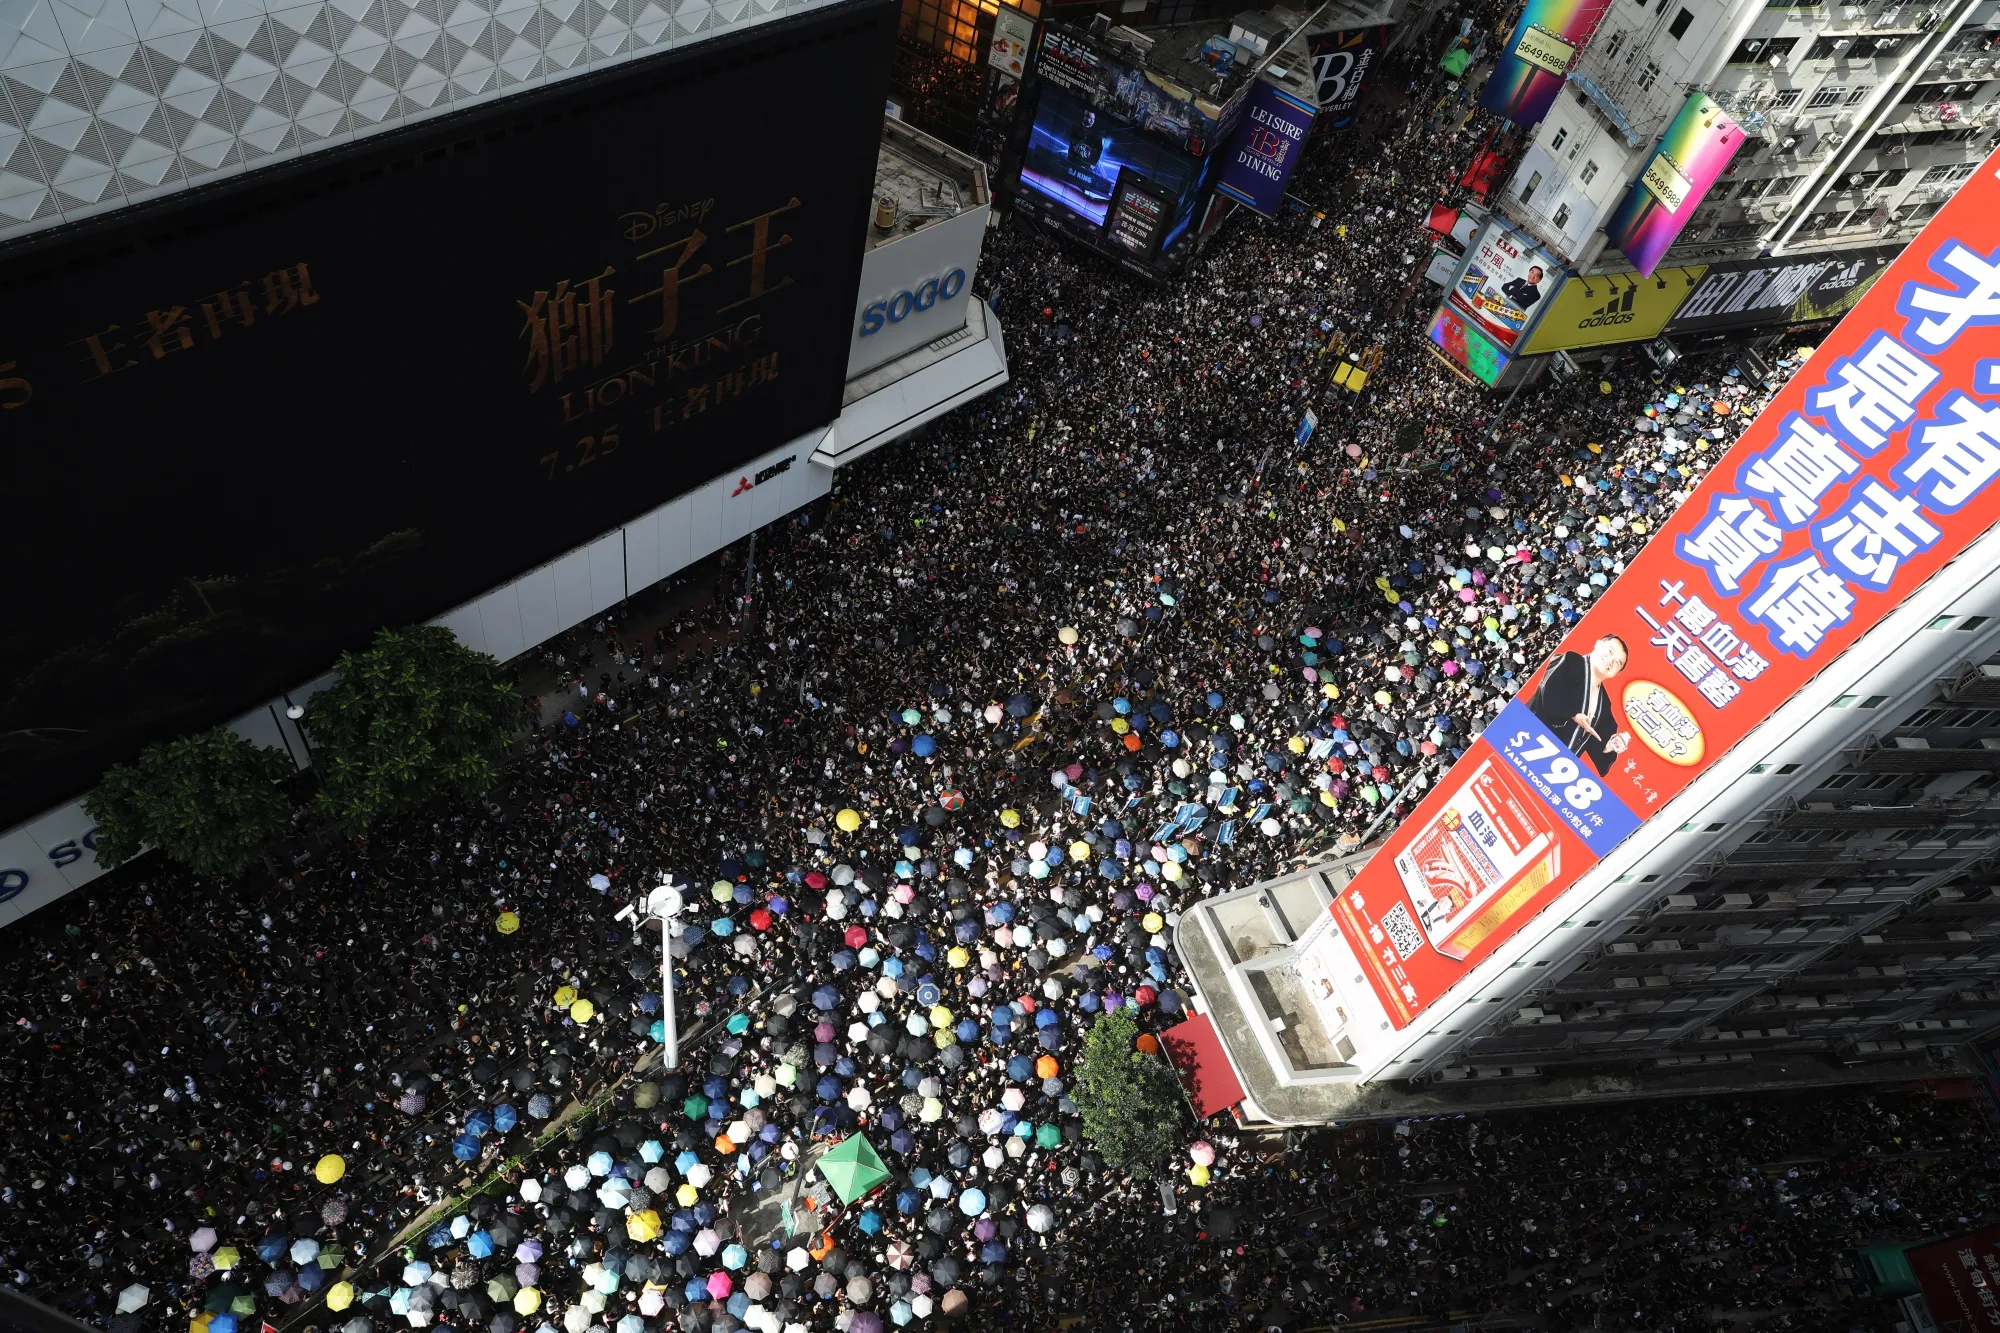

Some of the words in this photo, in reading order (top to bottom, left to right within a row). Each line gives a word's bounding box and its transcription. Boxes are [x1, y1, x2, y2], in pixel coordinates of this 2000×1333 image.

[1341, 48, 1375, 101] 金百利
[1250, 105, 1304, 141] LEISURE
[1319, 102, 1354, 114] EVERLEY
[1237, 150, 1282, 182] DINING
[1481, 244, 1504, 270] 中風
[1819, 277, 1857, 291] adidas
[64, 261, 321, 386] 王者再現
[516, 197, 802, 394] 獅子王
[860, 267, 966, 338] SOGO
[1578, 310, 1635, 330] adidas
[1674, 271, 1737, 319] FEEL
[1714, 266, 1780, 315] THE
[558, 359, 658, 424] LION
[667, 314, 763, 378] KING
[539, 423, 621, 481] 7.25
[645, 350, 780, 435] 王者再現
[1683, 244, 2000, 592] 才是真貨
[1749, 363, 2000, 654] 有志偉
[1635, 605, 1742, 710] 一天售罄
